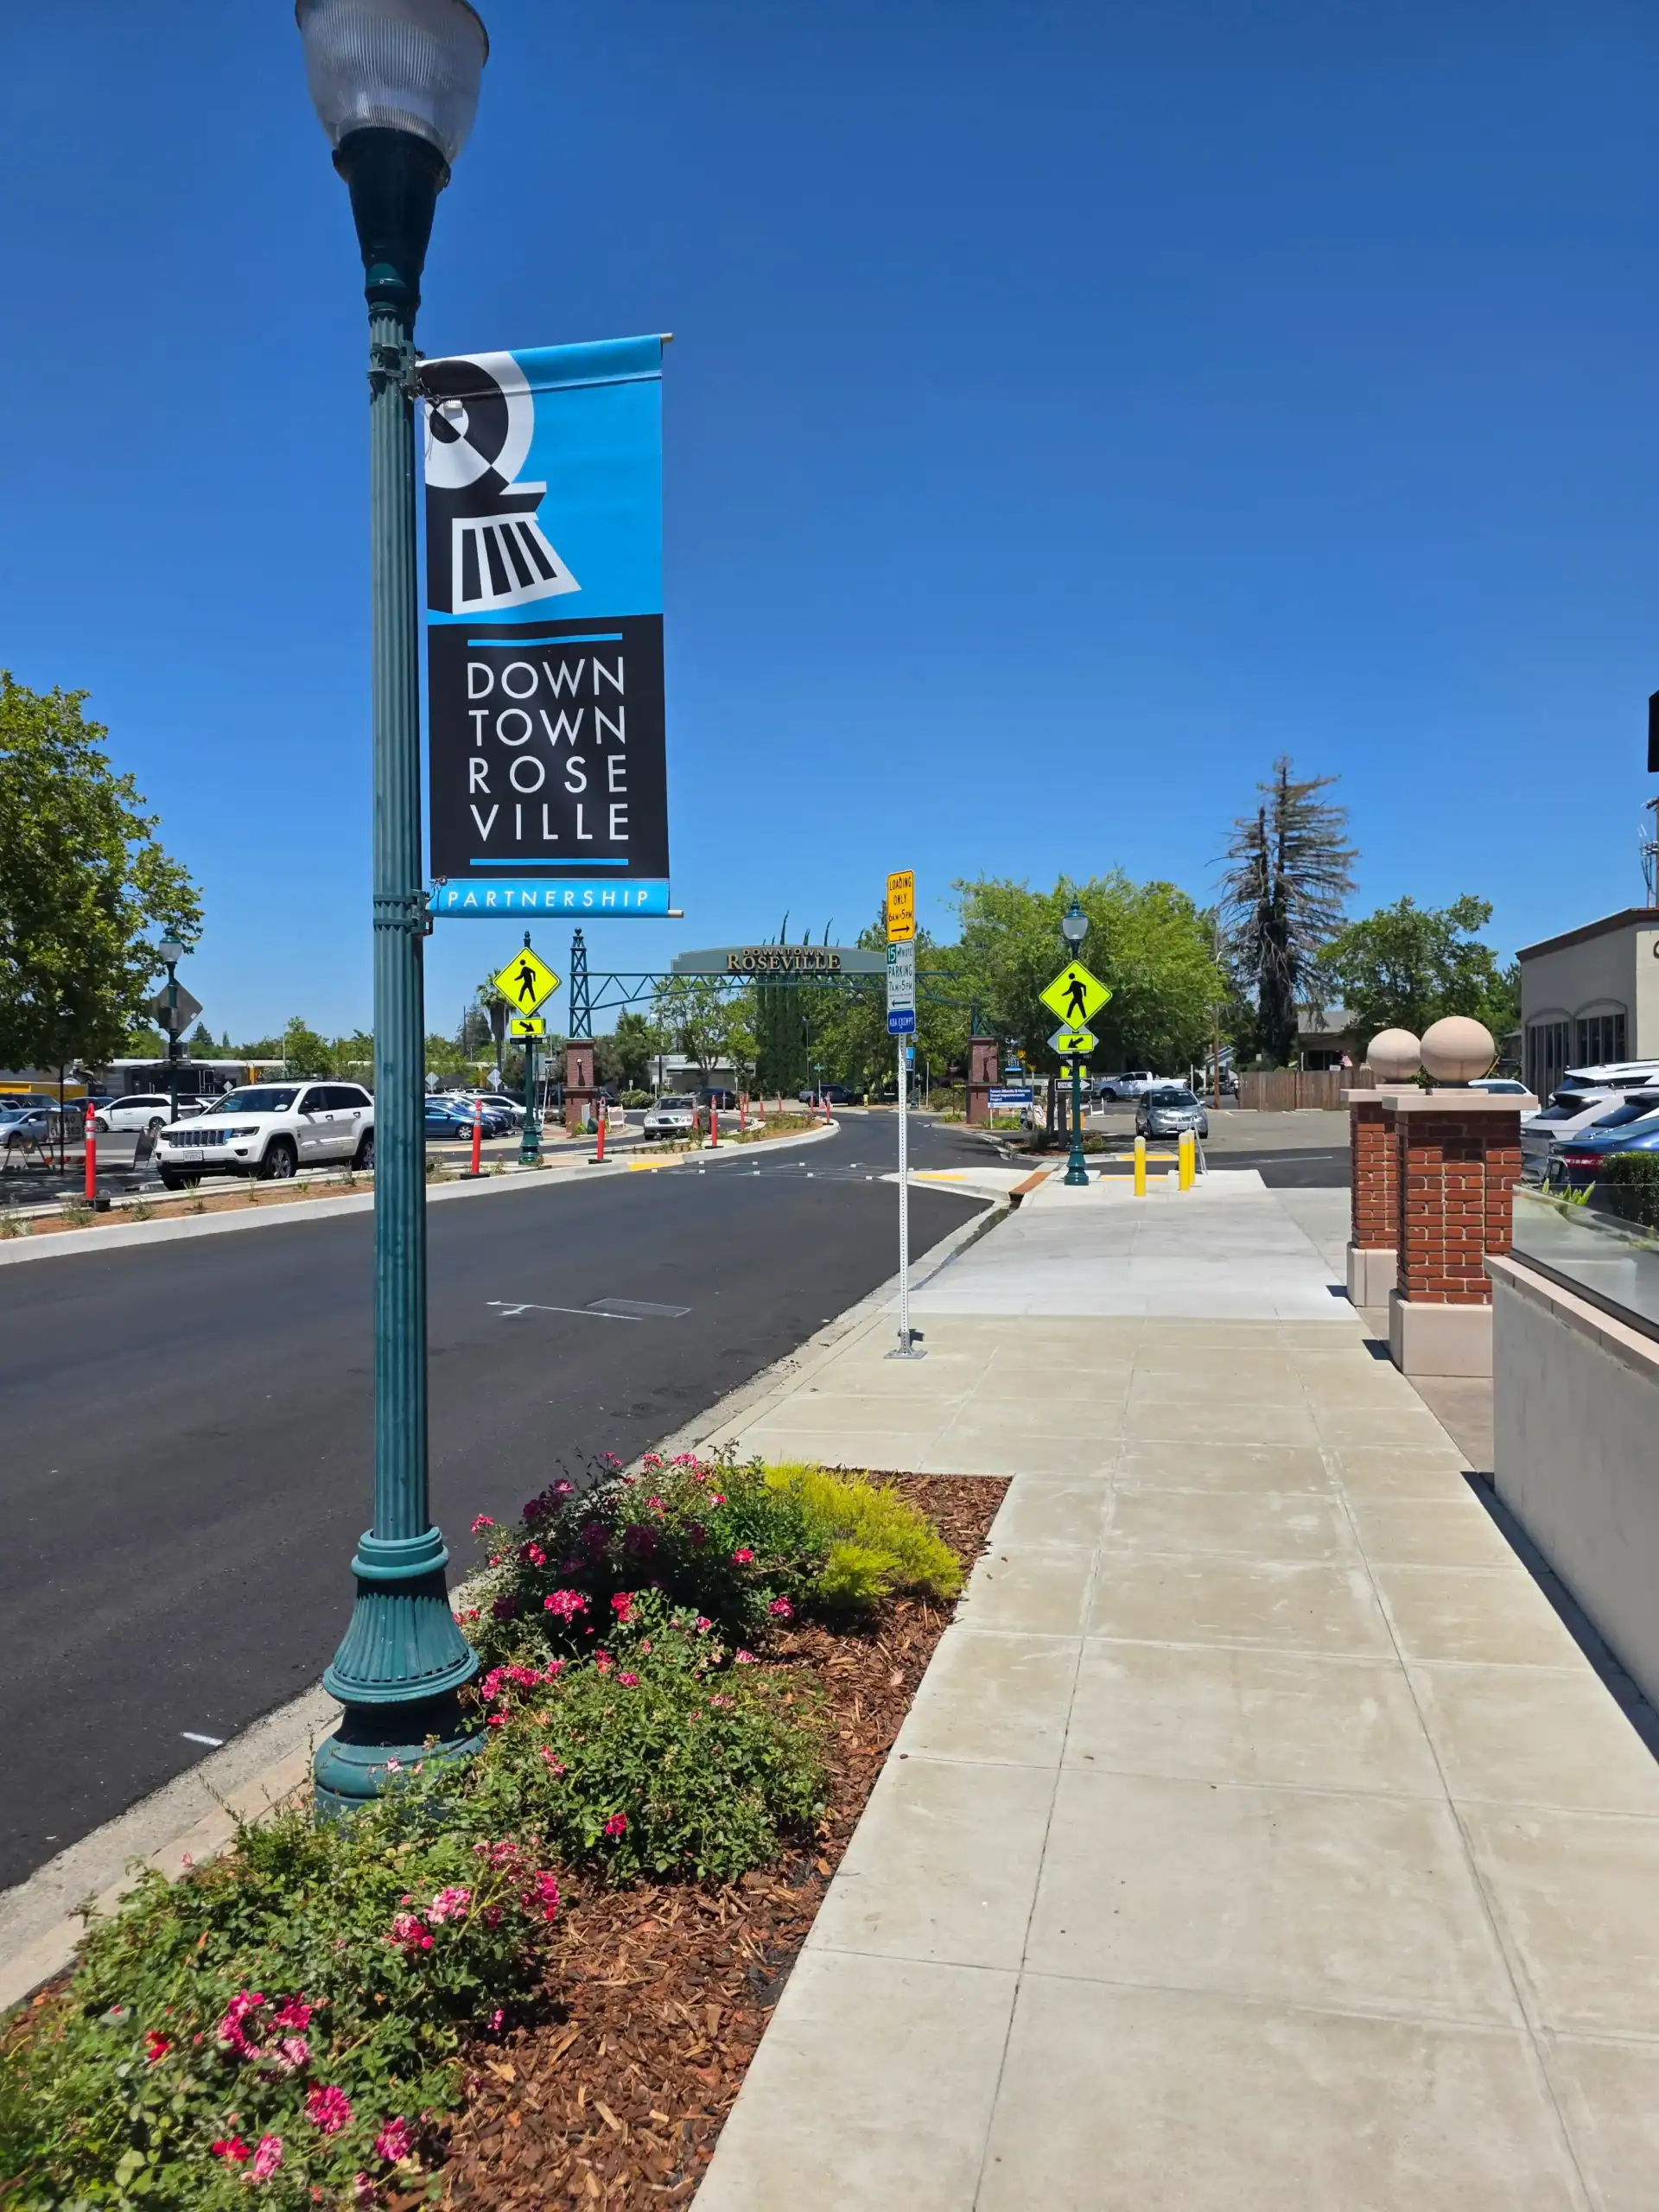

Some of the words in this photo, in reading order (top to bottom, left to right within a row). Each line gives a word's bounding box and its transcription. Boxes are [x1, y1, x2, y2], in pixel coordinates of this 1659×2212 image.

[467, 657, 624, 699] DOWN
[468, 705, 626, 747] TOWN
[469, 754, 627, 793] ROSE
[470, 804, 629, 842] VILLE
[889, 876, 912, 891] LOADING
[448, 890, 649, 907] PARTNERSHIP
[893, 893, 907, 906] ONLY
[727, 954, 841, 970] ROSEVILLE
[887, 946, 896, 962] 15
[888, 964, 912, 978] PARKING
[898, 1017, 913, 1026] EXEMPT
[51, 1126, 80, 1135] CLSED
